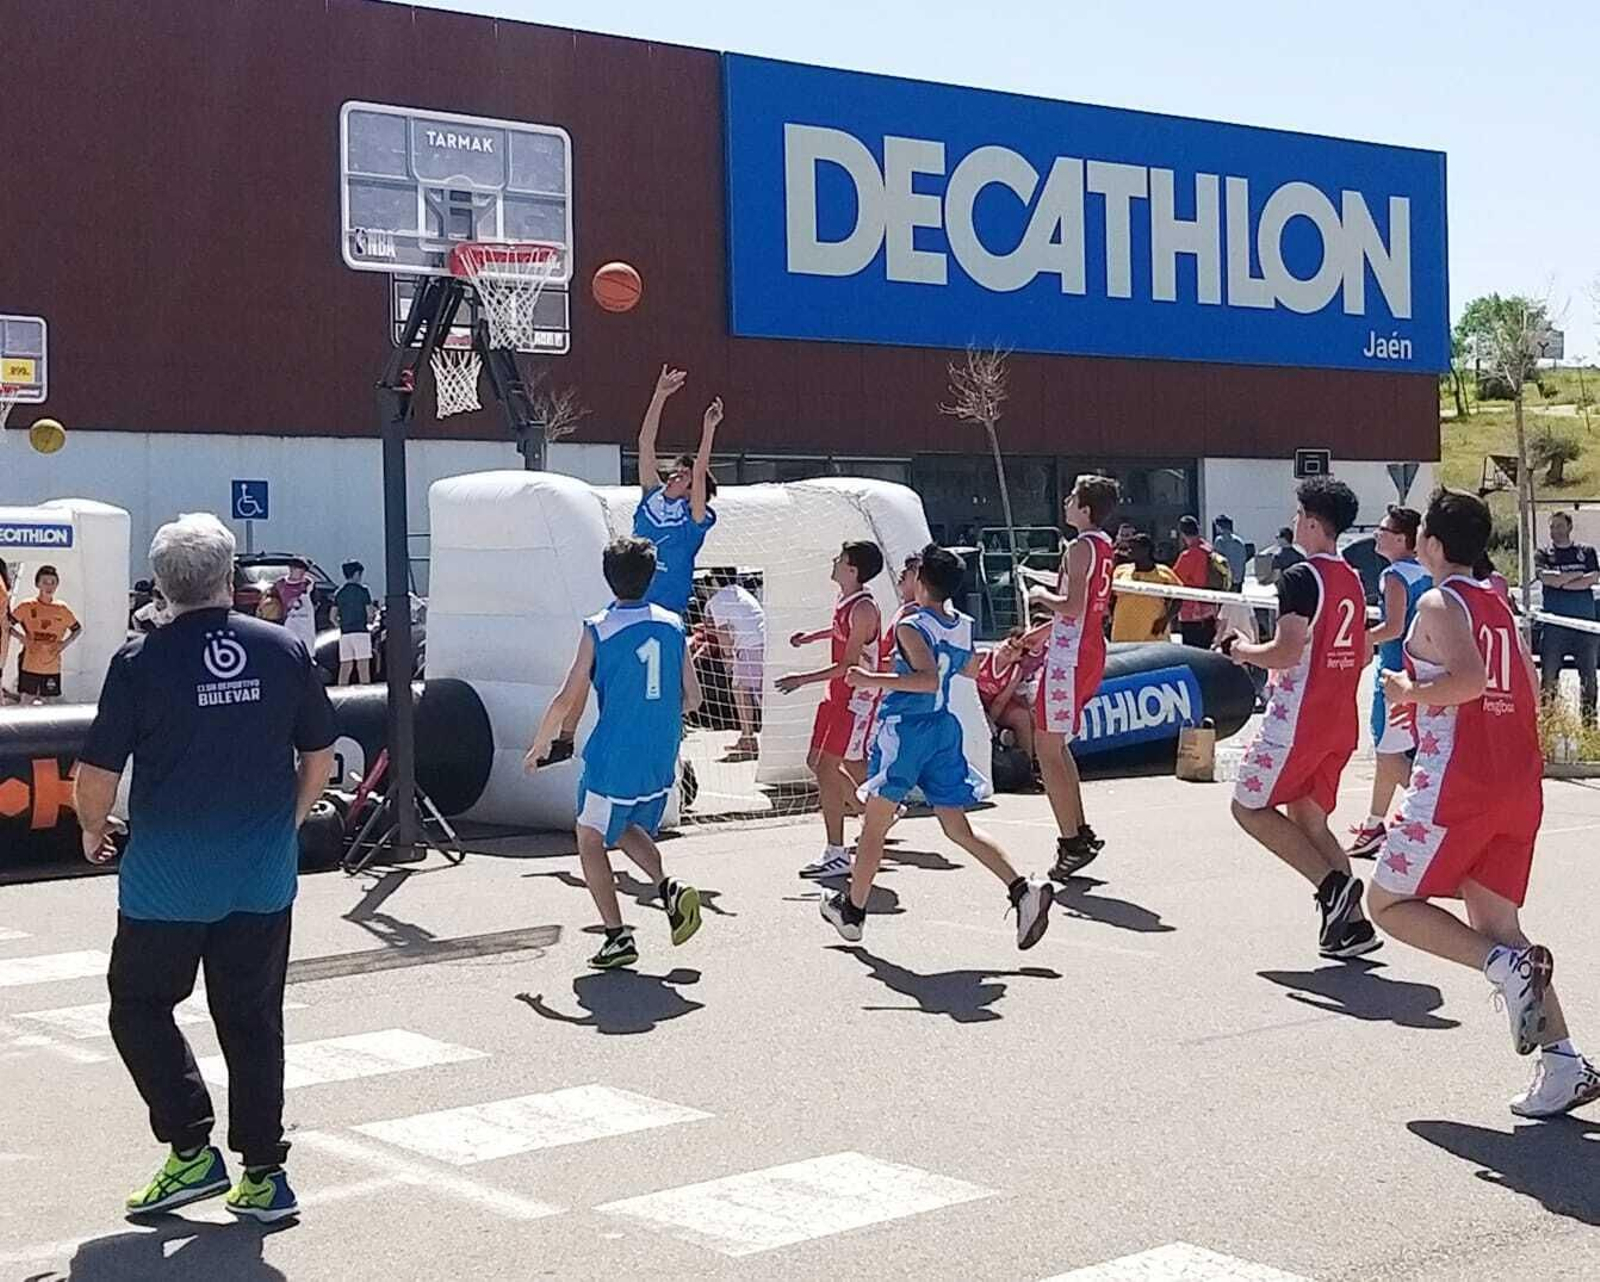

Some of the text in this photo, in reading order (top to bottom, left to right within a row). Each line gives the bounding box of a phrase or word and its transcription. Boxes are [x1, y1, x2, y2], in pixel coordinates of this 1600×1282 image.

[426, 131, 494, 153] TARMAK
[784, 122, 1412, 319] DECATHLON
[1363, 329, 1413, 361] Jaén
[0, 527, 68, 544] CATHLON
[1098, 558, 1112, 597] 5
[1333, 598, 1355, 648] 2
[635, 636, 661, 700] 1
[1479, 623, 1510, 691] 21
[198, 687, 261, 707] BULEVAR
